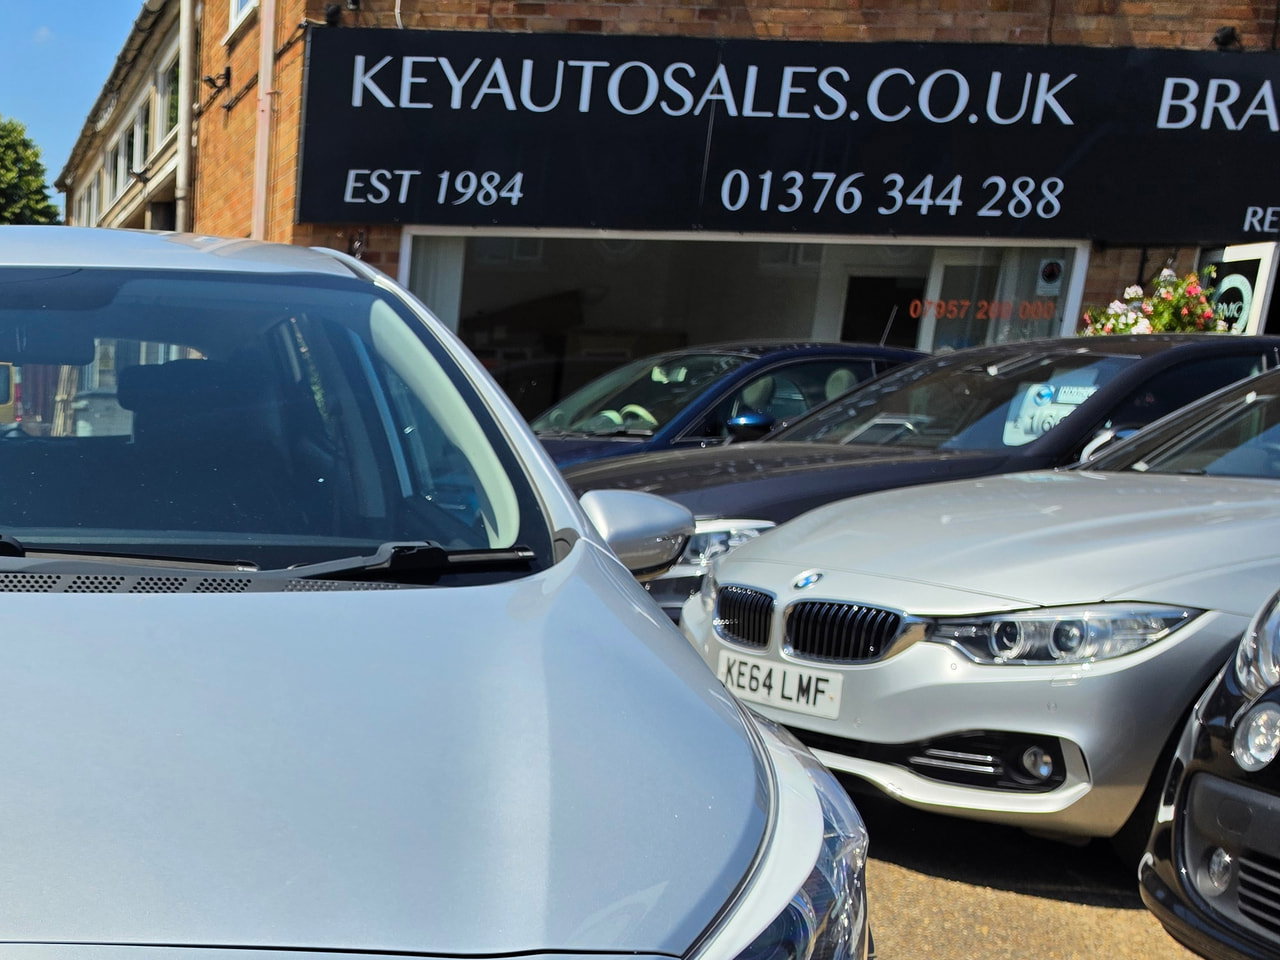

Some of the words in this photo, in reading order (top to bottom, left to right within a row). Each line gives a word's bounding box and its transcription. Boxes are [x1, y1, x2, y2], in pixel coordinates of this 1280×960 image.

[351, 54, 1078, 126] KEYAUTOSALES.CO.UK
[1156, 76, 1280, 132] BRA
[343, 168, 422, 204] EST
[436, 169, 525, 206] 1984
[720, 168, 865, 215] 01376
[877, 172, 963, 216] 344
[976, 174, 1065, 219] 288
[724, 657, 774, 697] KE64
[780, 670, 830, 707] LMF
